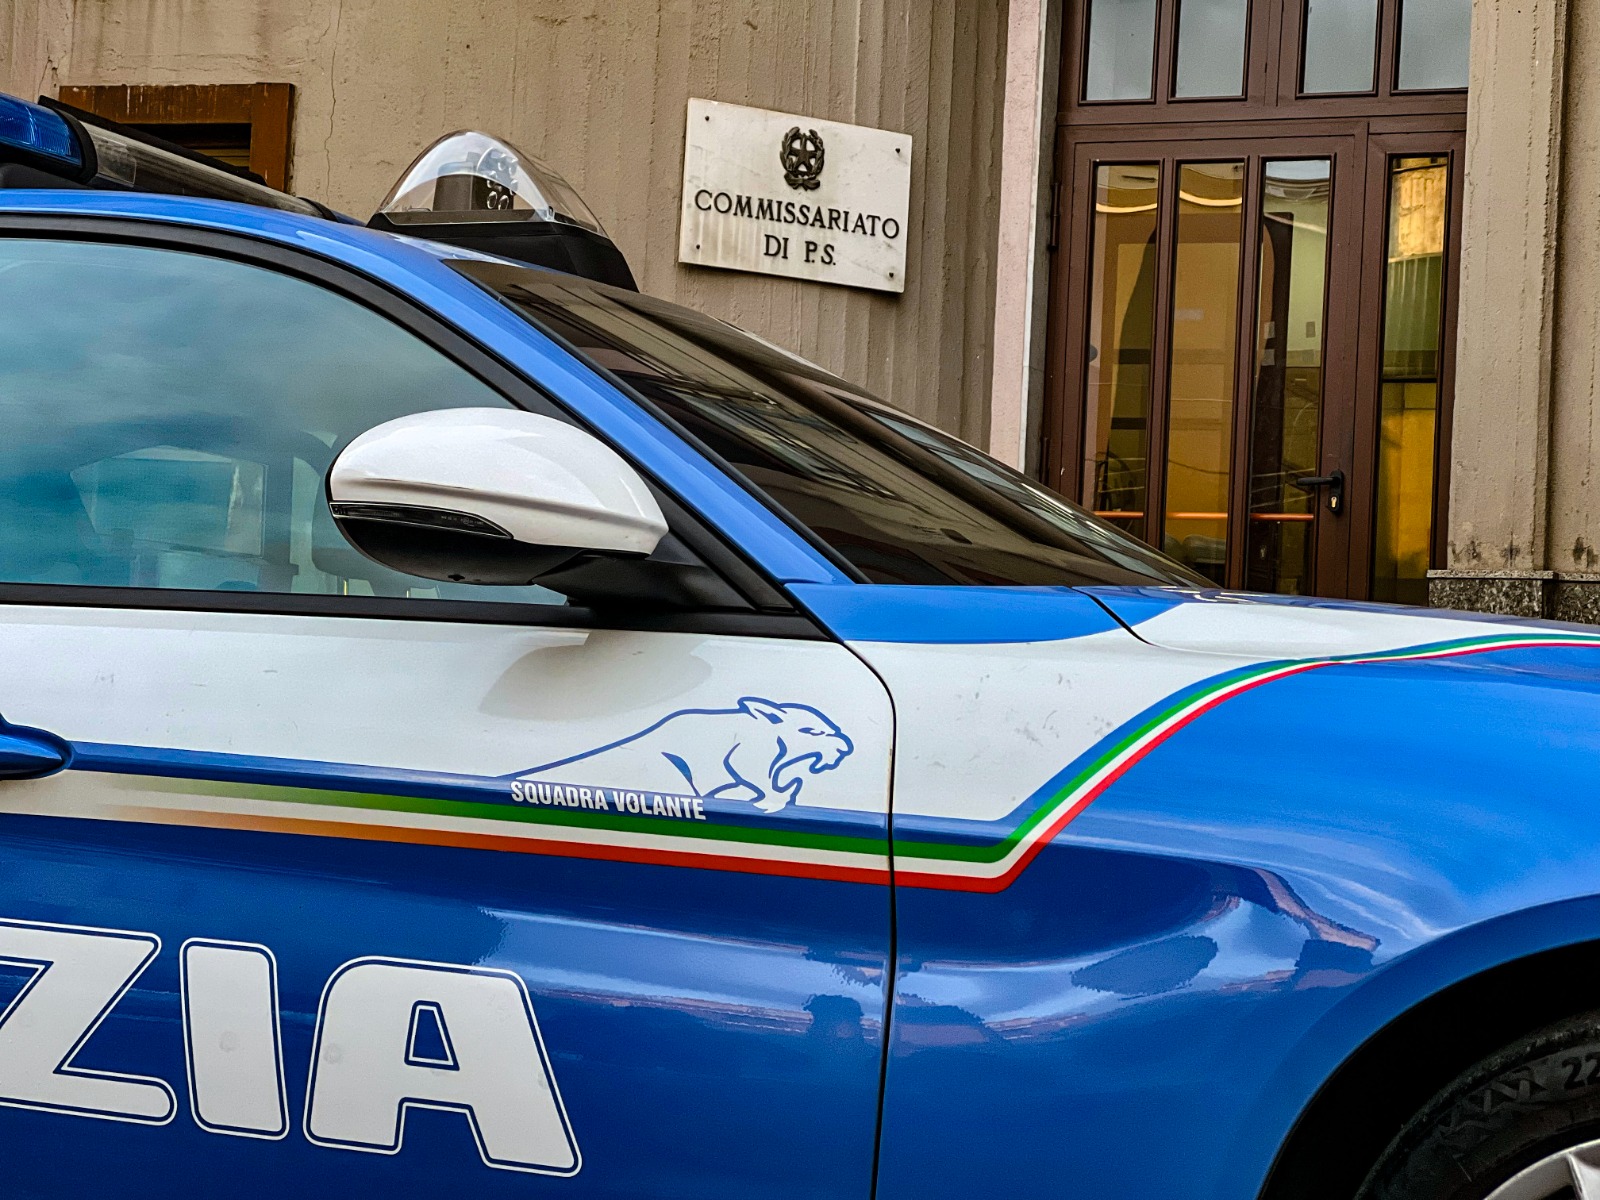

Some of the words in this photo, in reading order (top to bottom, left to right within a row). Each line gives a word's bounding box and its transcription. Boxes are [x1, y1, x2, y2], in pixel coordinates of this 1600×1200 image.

[694, 189, 900, 240] COMMISSARIATO
[764, 234, 789, 260] DI
[804, 240, 837, 266] P.S.
[510, 780, 608, 811] SQUADRA
[612, 789, 706, 820] VOLANTE
